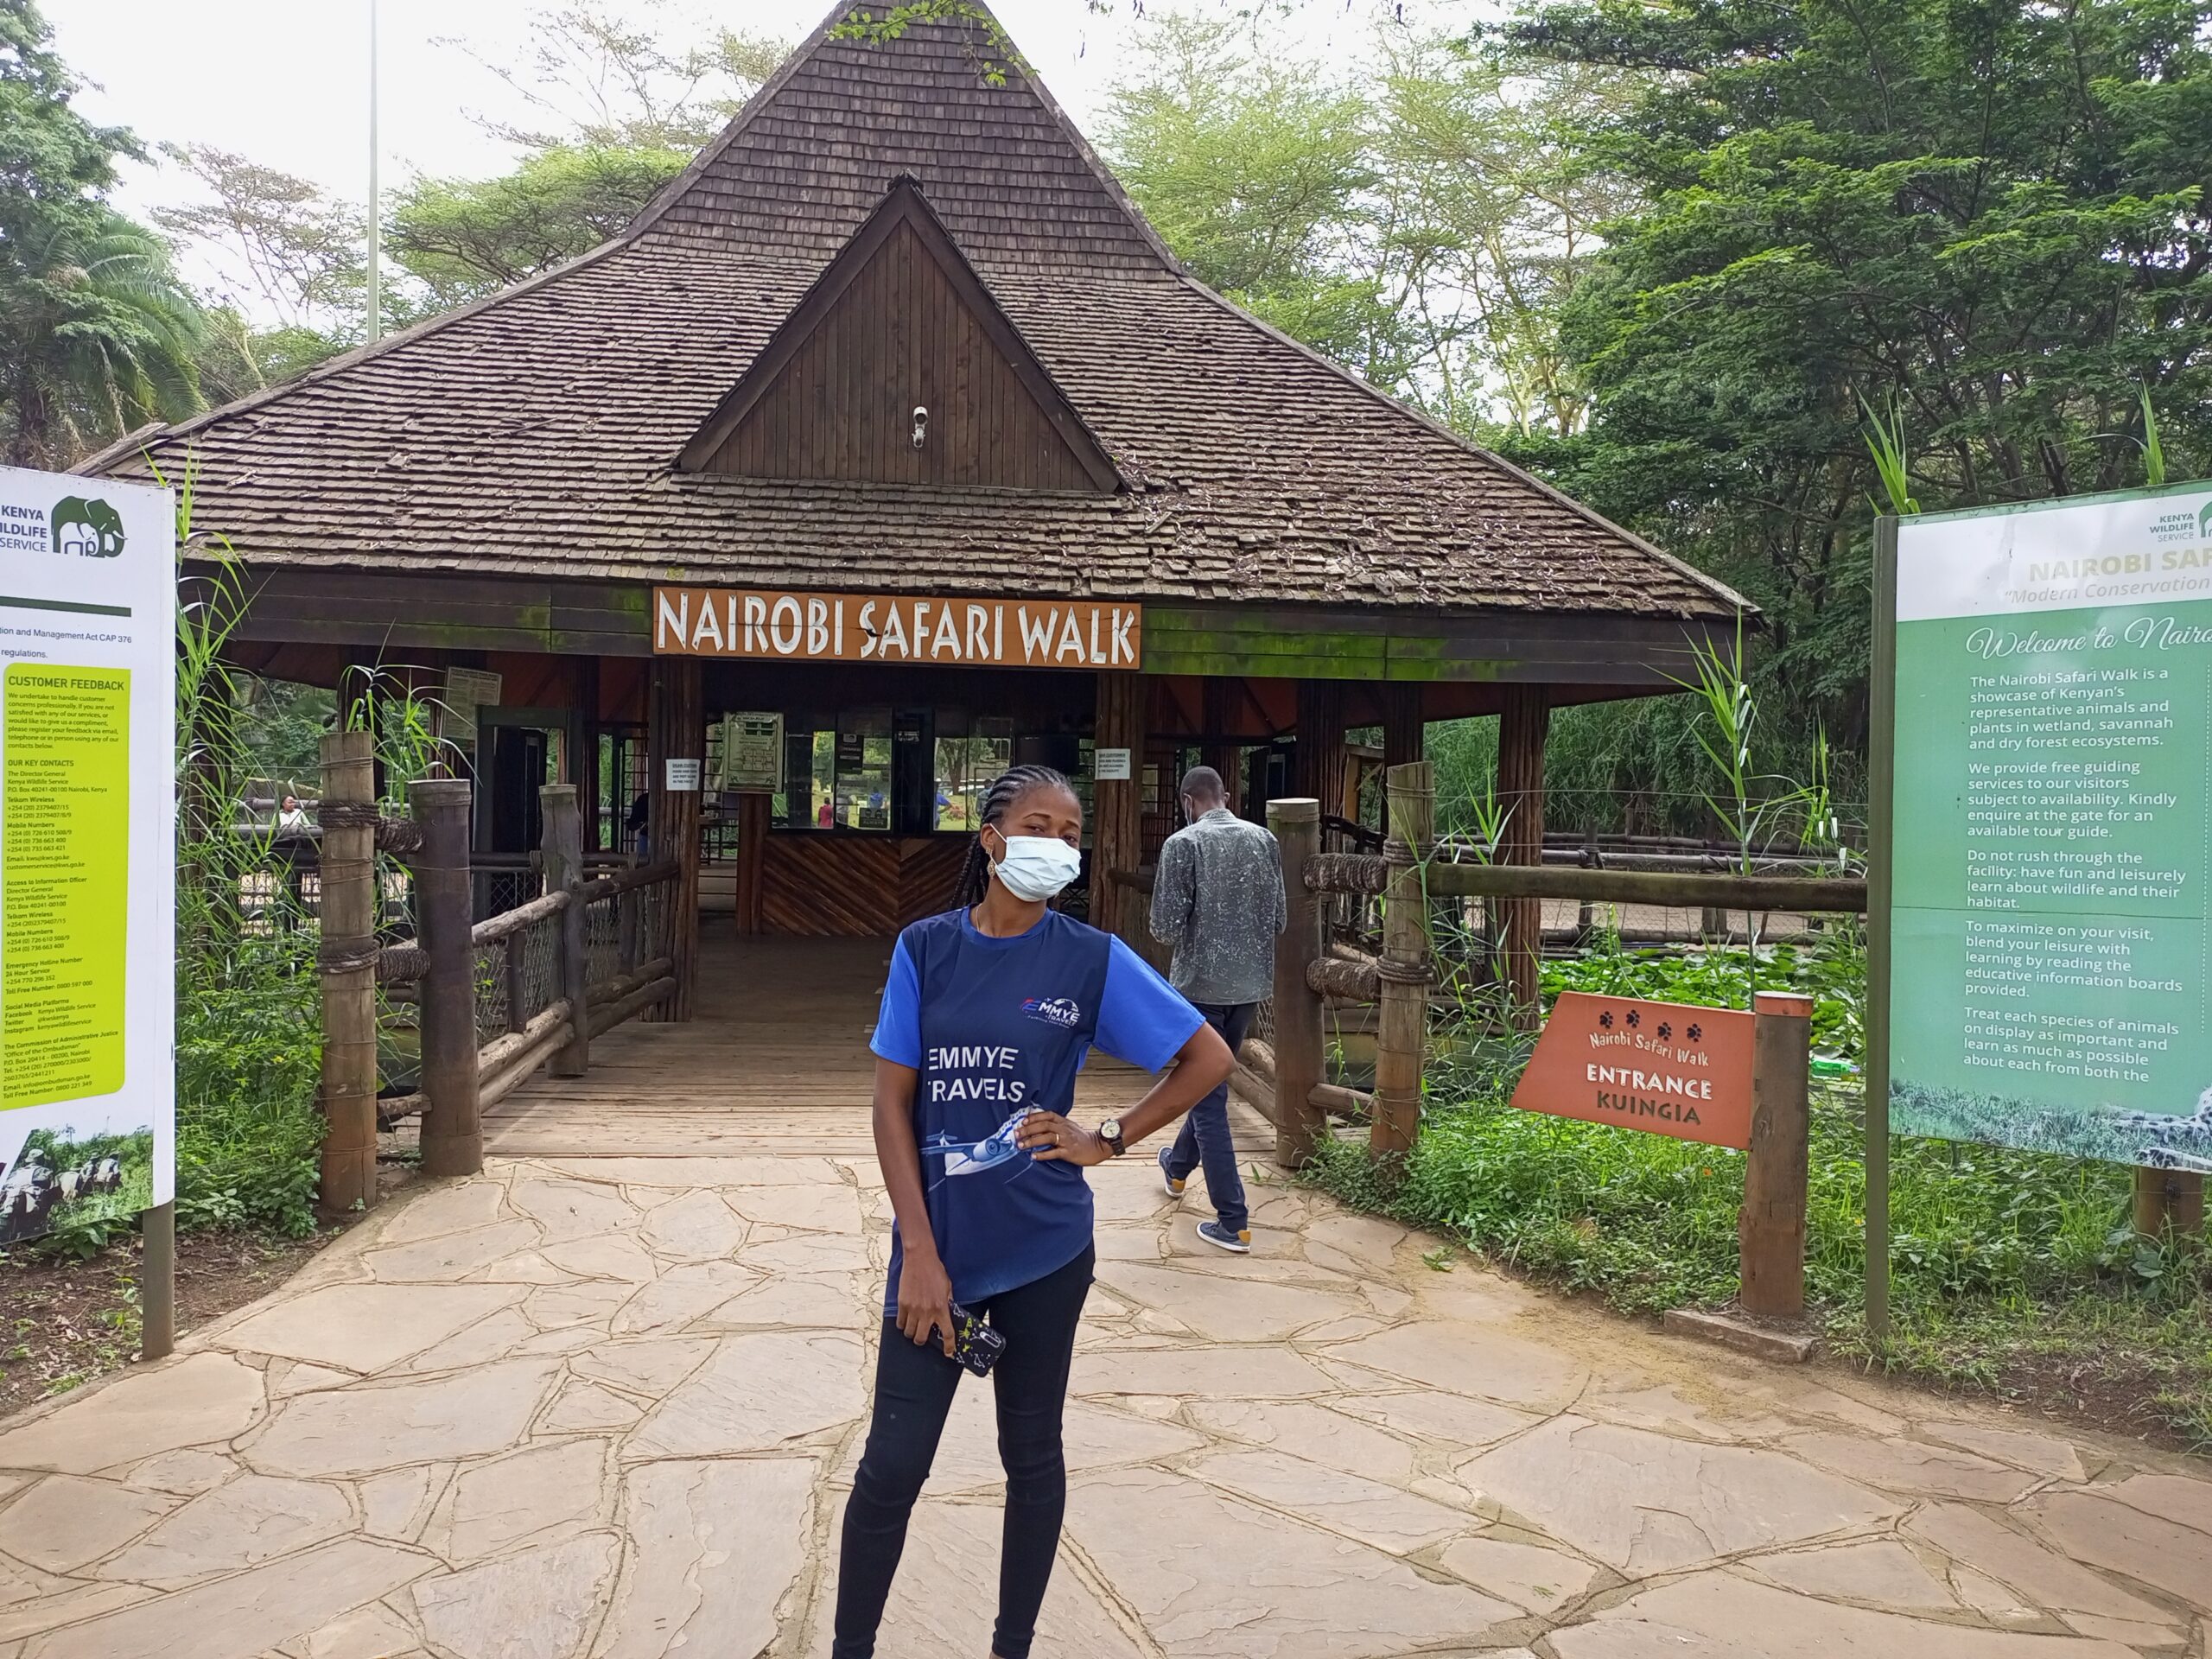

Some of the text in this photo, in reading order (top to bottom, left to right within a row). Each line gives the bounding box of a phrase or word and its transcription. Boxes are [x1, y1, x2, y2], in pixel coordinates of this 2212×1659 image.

[2, 505, 44, 521] KENYA
[2160, 513, 2194, 523] KENYA
[2150, 523, 2194, 533] WILDLIFE
[2158, 532, 2194, 542] SERVICE
[0, 537, 47, 552] SERVICE
[2030, 553, 2152, 582] NAIROBI
[2086, 577, 2210, 598] Conservation
[34, 629, 84, 639] Management
[658, 590, 1135, 664] NAIROBI SAFARI WALK
[1966, 627, 2087, 659] Welcome
[2094, 626, 2116, 649] to
[9, 677, 124, 690] CUSTOMER FEEDBACK
[1970, 668, 2168, 687] The Nairobi Safari Walk is a
[1970, 691, 2037, 703] showcase
[2041, 688, 2056, 700] of
[1970, 700, 2169, 720] representative animals and
[1970, 717, 2173, 736] plants in wetland, savannah
[1969, 734, 2163, 751] and dry forest ecosystems.
[1968, 760, 2140, 776] We provide free guiding
[1968, 778, 2129, 790] services to our visitors
[1968, 793, 2177, 807] subject to availability. Kindly
[1968, 809, 2152, 823] enquire at the gate for an
[1967, 826, 2113, 840] available tour guide.
[1967, 850, 2143, 866] Do not rush through the
[1967, 865, 2186, 884] facility: have fun and leisurely
[1967, 881, 2179, 898] learn about wildlife and their
[1967, 897, 2020, 908] habitat.
[1967, 921, 2154, 942] To maximize on your visit,
[1967, 936, 2131, 955] blend your leisure with
[1966, 951, 2132, 972] learning by reading the
[1965, 968, 2183, 992] educative information boards
[1965, 984, 2030, 997] provided.
[1964, 1007, 2179, 1035] Treat each species of animals
[1964, 1024, 2167, 1051] on display as important and
[929, 1046, 1019, 1070] EMMYE
[1589, 1030, 1709, 1067] Nairobi Safari Walk
[1964, 1038, 2149, 1065] learn as much as possible
[1963, 1054, 2150, 1082] about each from both the
[928, 1078, 1026, 1103] RAVELS
[1586, 1063, 1713, 1100] ENTRANCE
[1597, 1091, 1700, 1125] KUINGIA
